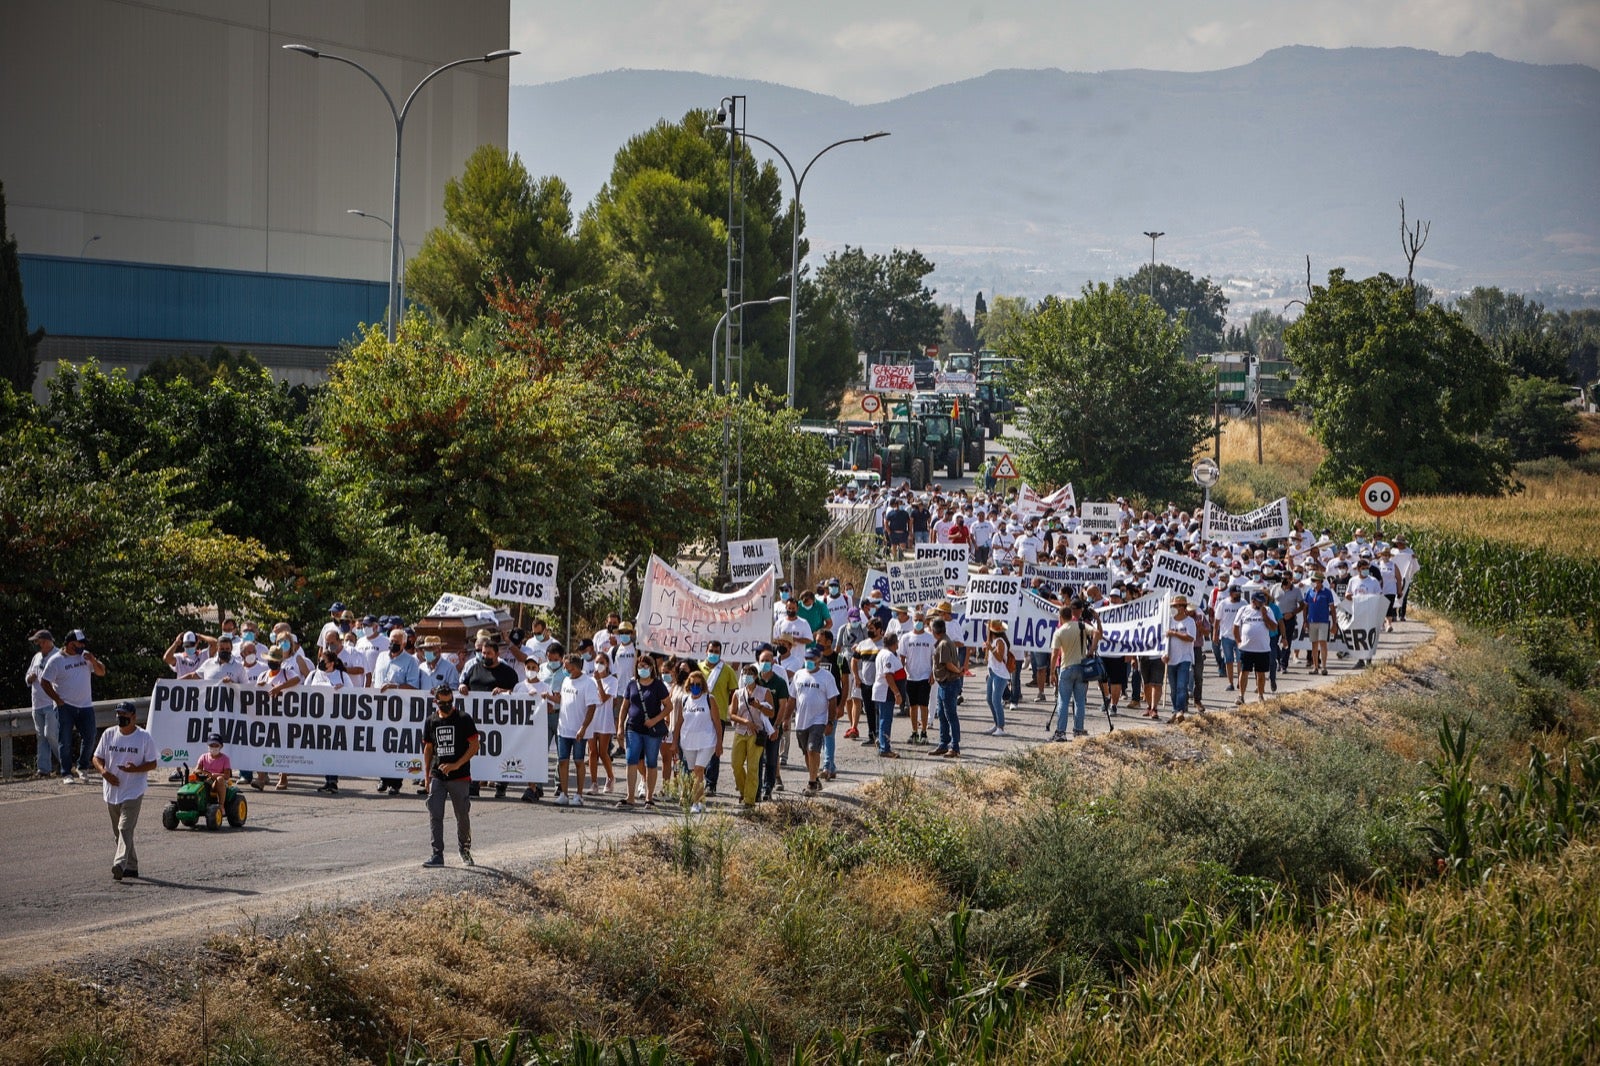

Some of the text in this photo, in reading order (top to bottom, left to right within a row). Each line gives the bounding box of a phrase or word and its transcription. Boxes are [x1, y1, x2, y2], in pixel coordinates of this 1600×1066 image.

[1368, 490, 1391, 503] 60
[1209, 521, 1229, 531] PARA
[1230, 523, 1239, 531] EL
[742, 544, 764, 558] POR LA
[917, 548, 966, 562] PRECIOS
[495, 556, 554, 577] PRECIOS
[1025, 565, 1036, 575] LOS
[1070, 570, 1109, 581] SUPLICAMOS
[1157, 554, 1206, 582] PRECIOS
[495, 578, 543, 598] JUSTOS
[891, 575, 945, 592] CON EL SECTOR
[970, 579, 1018, 595] PRECIOS
[1153, 573, 1197, 597] JUSTOS
[892, 592, 917, 604] LACTEO
[970, 600, 1009, 615] JUSTOS
[648, 611, 742, 634] DIRECTO
[663, 635, 678, 648] LA
[1013, 616, 1059, 648] LACT
[1099, 621, 1166, 653] SPAÑOL
[154, 685, 200, 712] POR
[204, 686, 235, 713] UN
[240, 690, 325, 718] PRECIO
[330, 693, 403, 722] JUSTO
[410, 696, 437, 723] DE
[472, 698, 537, 726] LECHE
[187, 718, 502, 757] DE VACA PARA EL GANRO
[174, 749, 189, 758] UPA
